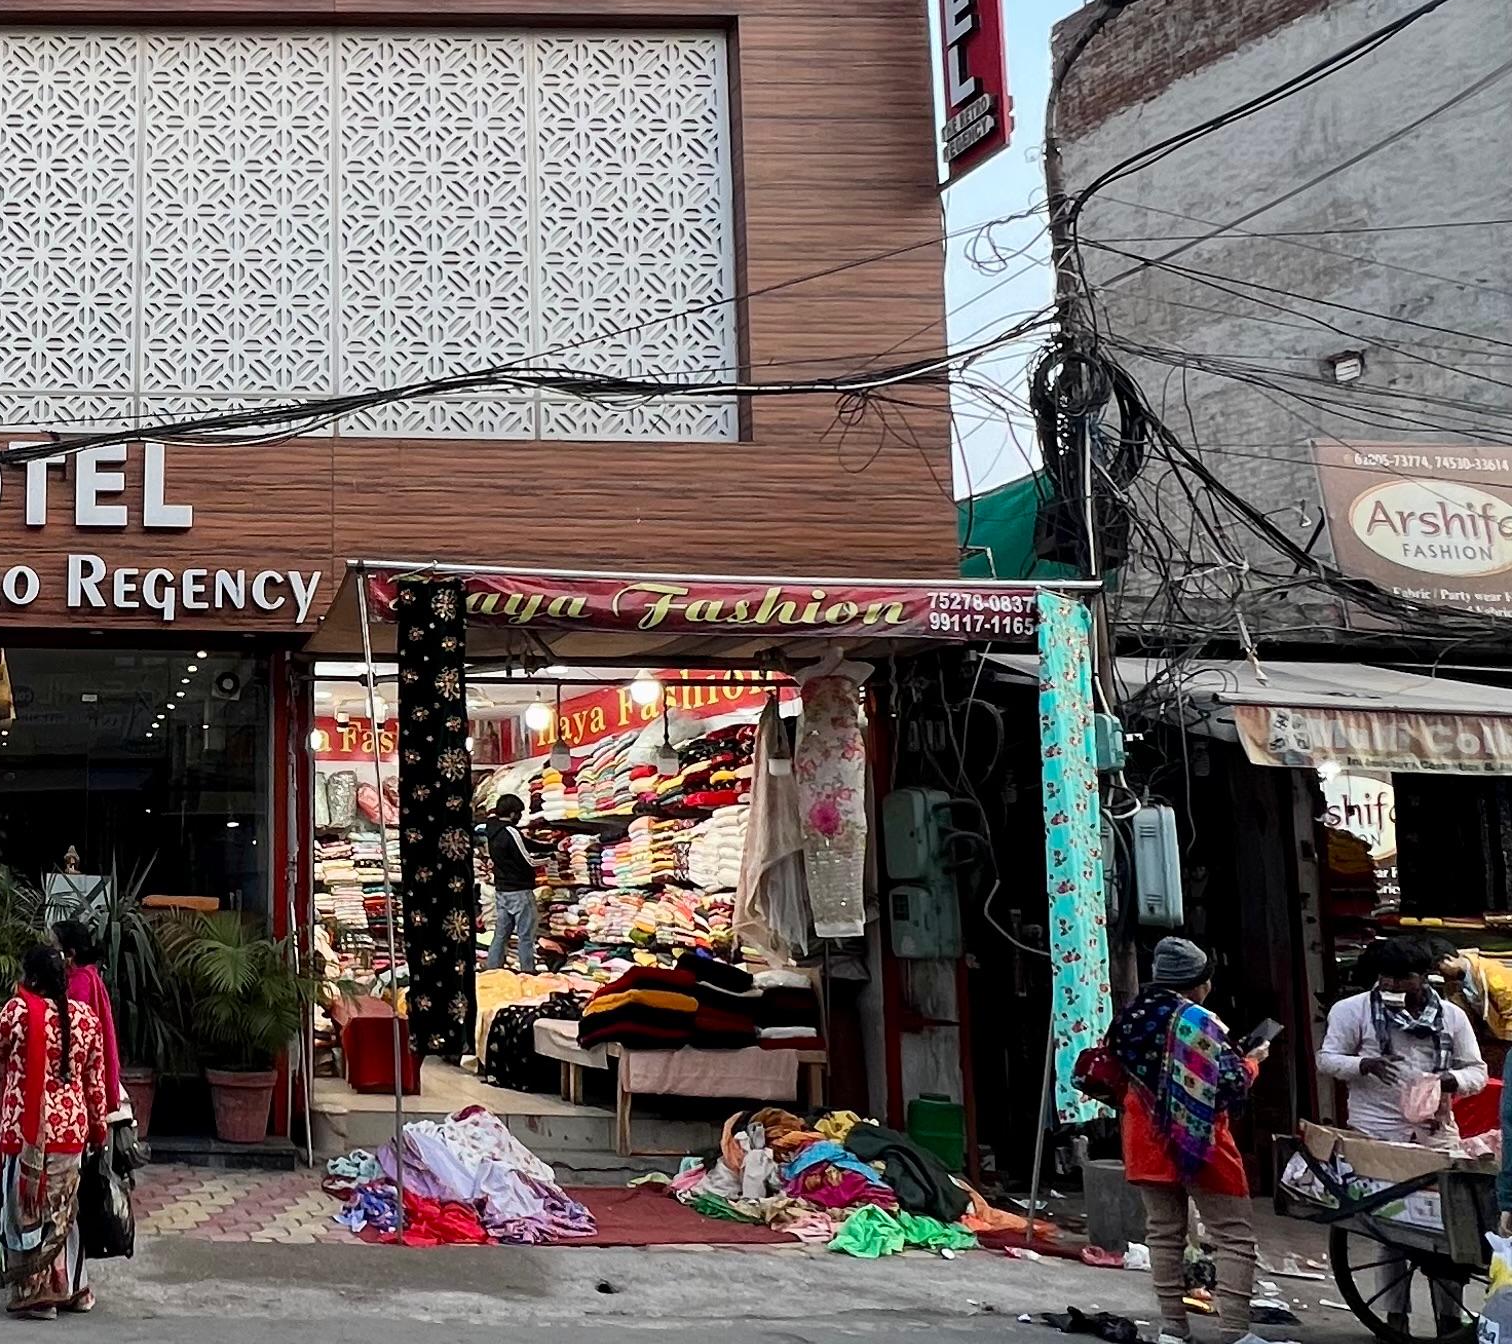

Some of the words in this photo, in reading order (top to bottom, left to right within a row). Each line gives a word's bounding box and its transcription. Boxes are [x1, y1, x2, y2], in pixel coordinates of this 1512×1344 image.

[1402, 543, 1493, 561] FASHION
[67, 553, 322, 624] REGENCY
[389, 590, 592, 626] aya
[611, 582, 910, 630] Fashion
[926, 591, 1038, 614] 75278-0837
[929, 611, 1040, 636] 99117-1165
